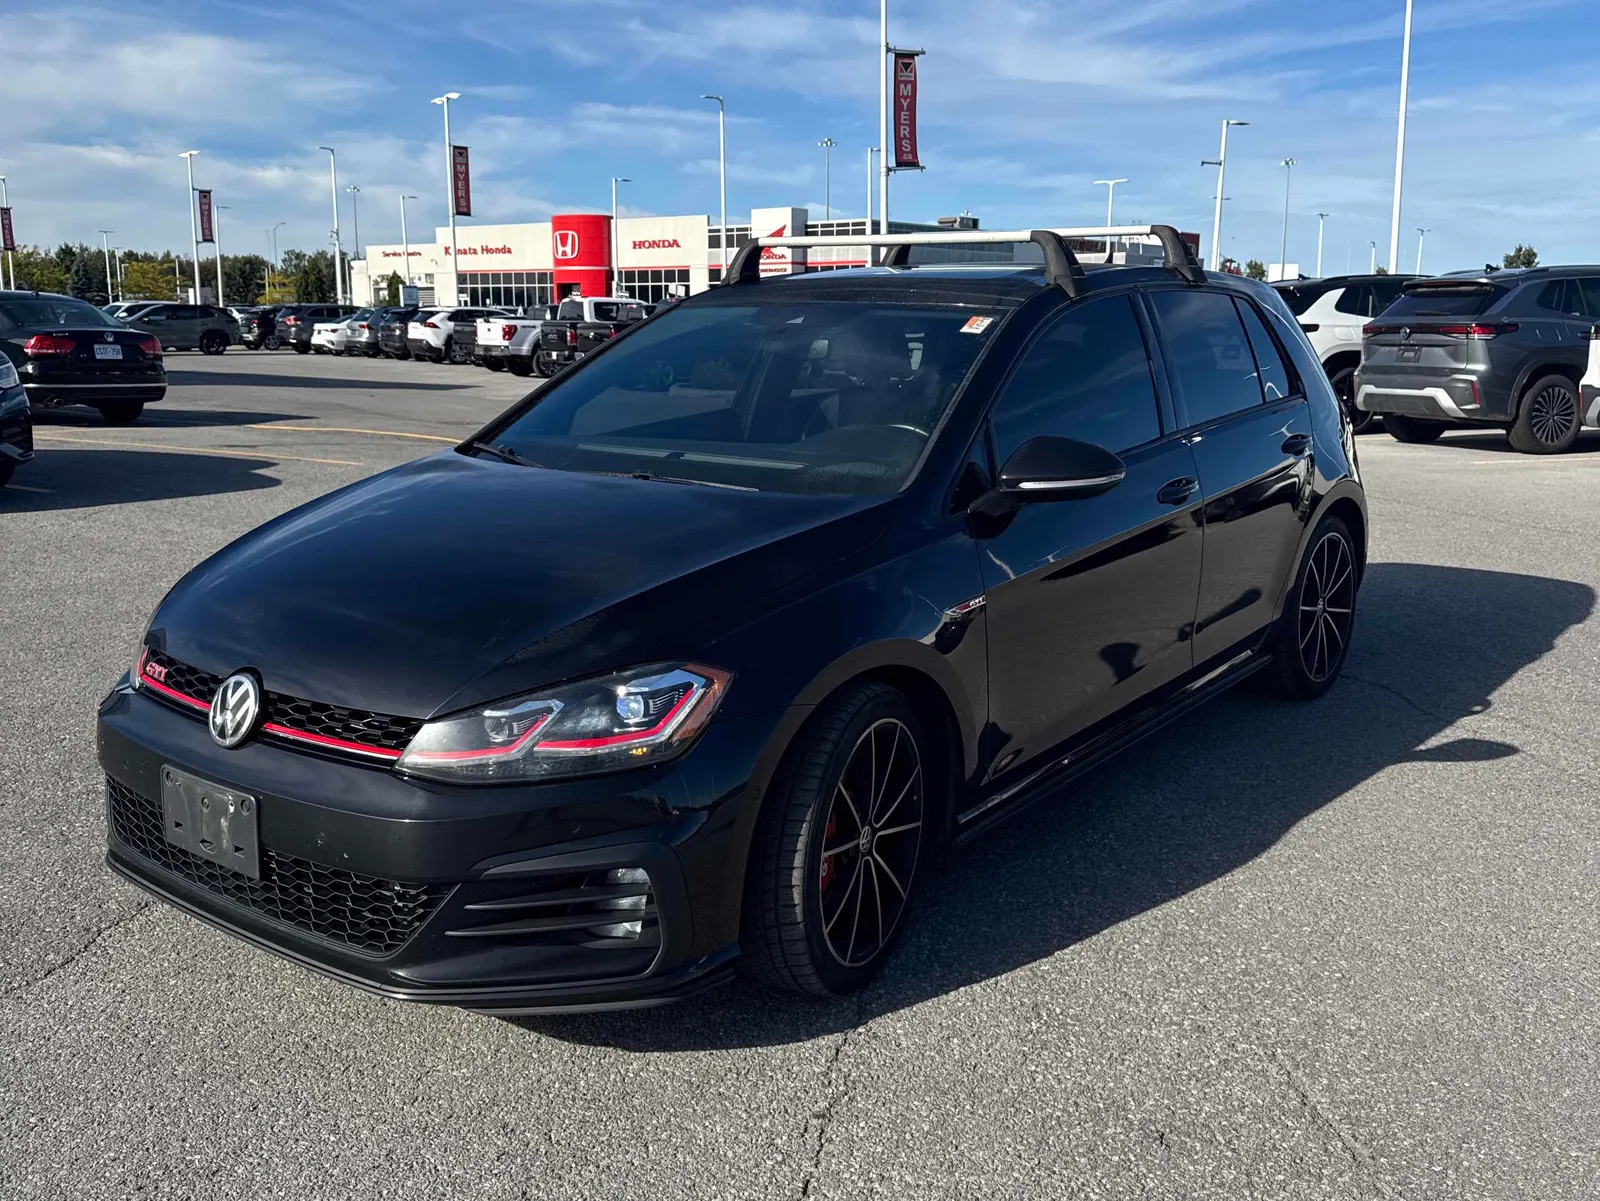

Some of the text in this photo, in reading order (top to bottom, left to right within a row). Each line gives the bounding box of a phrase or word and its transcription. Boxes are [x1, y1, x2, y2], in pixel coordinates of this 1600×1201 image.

[899, 83, 912, 152] MYERS
[456, 164, 467, 206] MYERS
[444, 244, 512, 256] Knata Honda
[632, 239, 681, 250] HONDA
[969, 596, 985, 607] GTI
[146, 661, 168, 682] GTI
